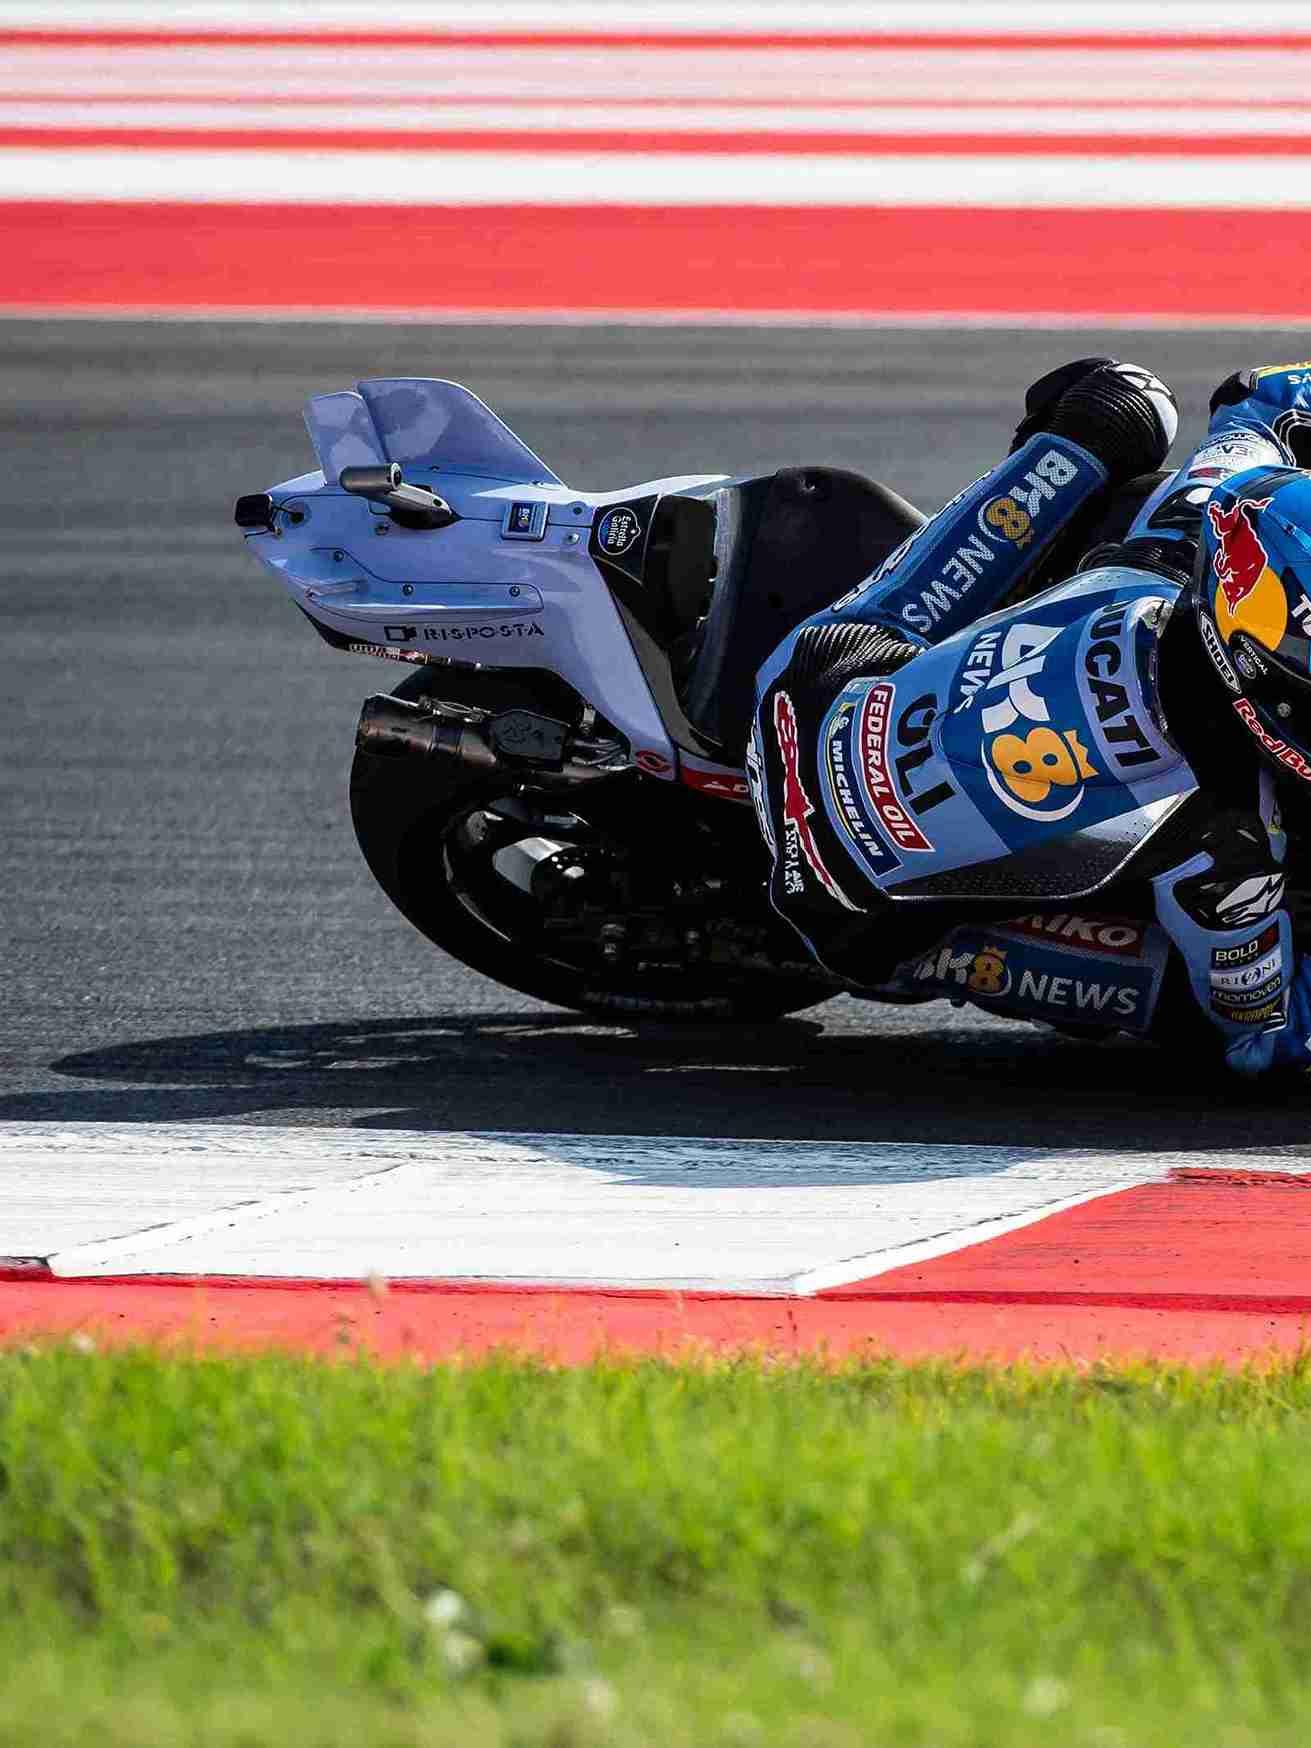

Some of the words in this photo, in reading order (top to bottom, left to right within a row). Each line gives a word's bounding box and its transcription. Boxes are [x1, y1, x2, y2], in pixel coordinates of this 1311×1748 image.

[978, 449, 1078, 549] BK8
[424, 622, 544, 640] RISPOSTA
[902, 534, 995, 633] NEWS
[1202, 625, 1235, 684] SHOEI
[867, 690, 889, 797] FEDERAL
[882, 804, 915, 842] OIL
[981, 624, 1099, 822] BK8
[831, 740, 884, 857] MICHELIN
[1019, 970, 1140, 1015] NEWS
[1216, 941, 1258, 961] BOLD
